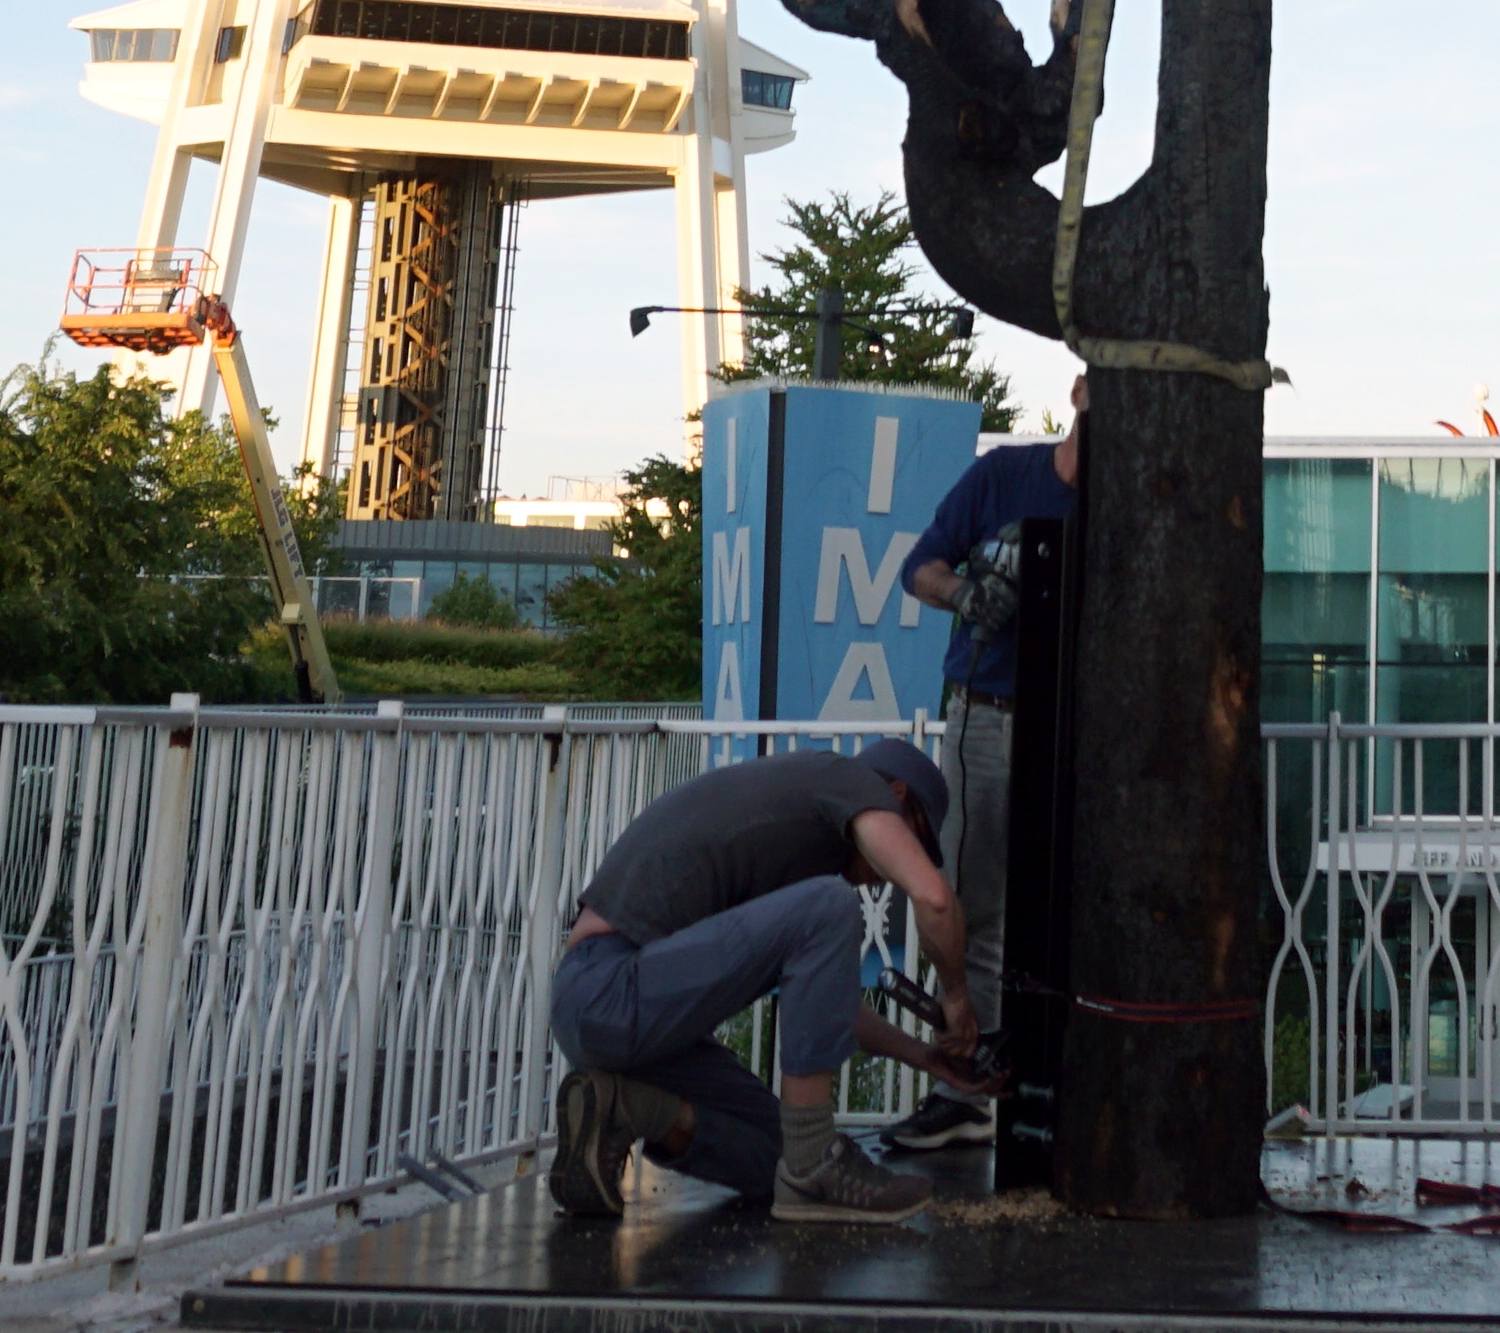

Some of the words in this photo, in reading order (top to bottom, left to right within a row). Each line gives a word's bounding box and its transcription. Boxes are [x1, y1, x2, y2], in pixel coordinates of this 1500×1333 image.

[270, 488, 289, 528] JLG
[283, 530, 304, 579] LIFT
[810, 416, 922, 740] IMA
